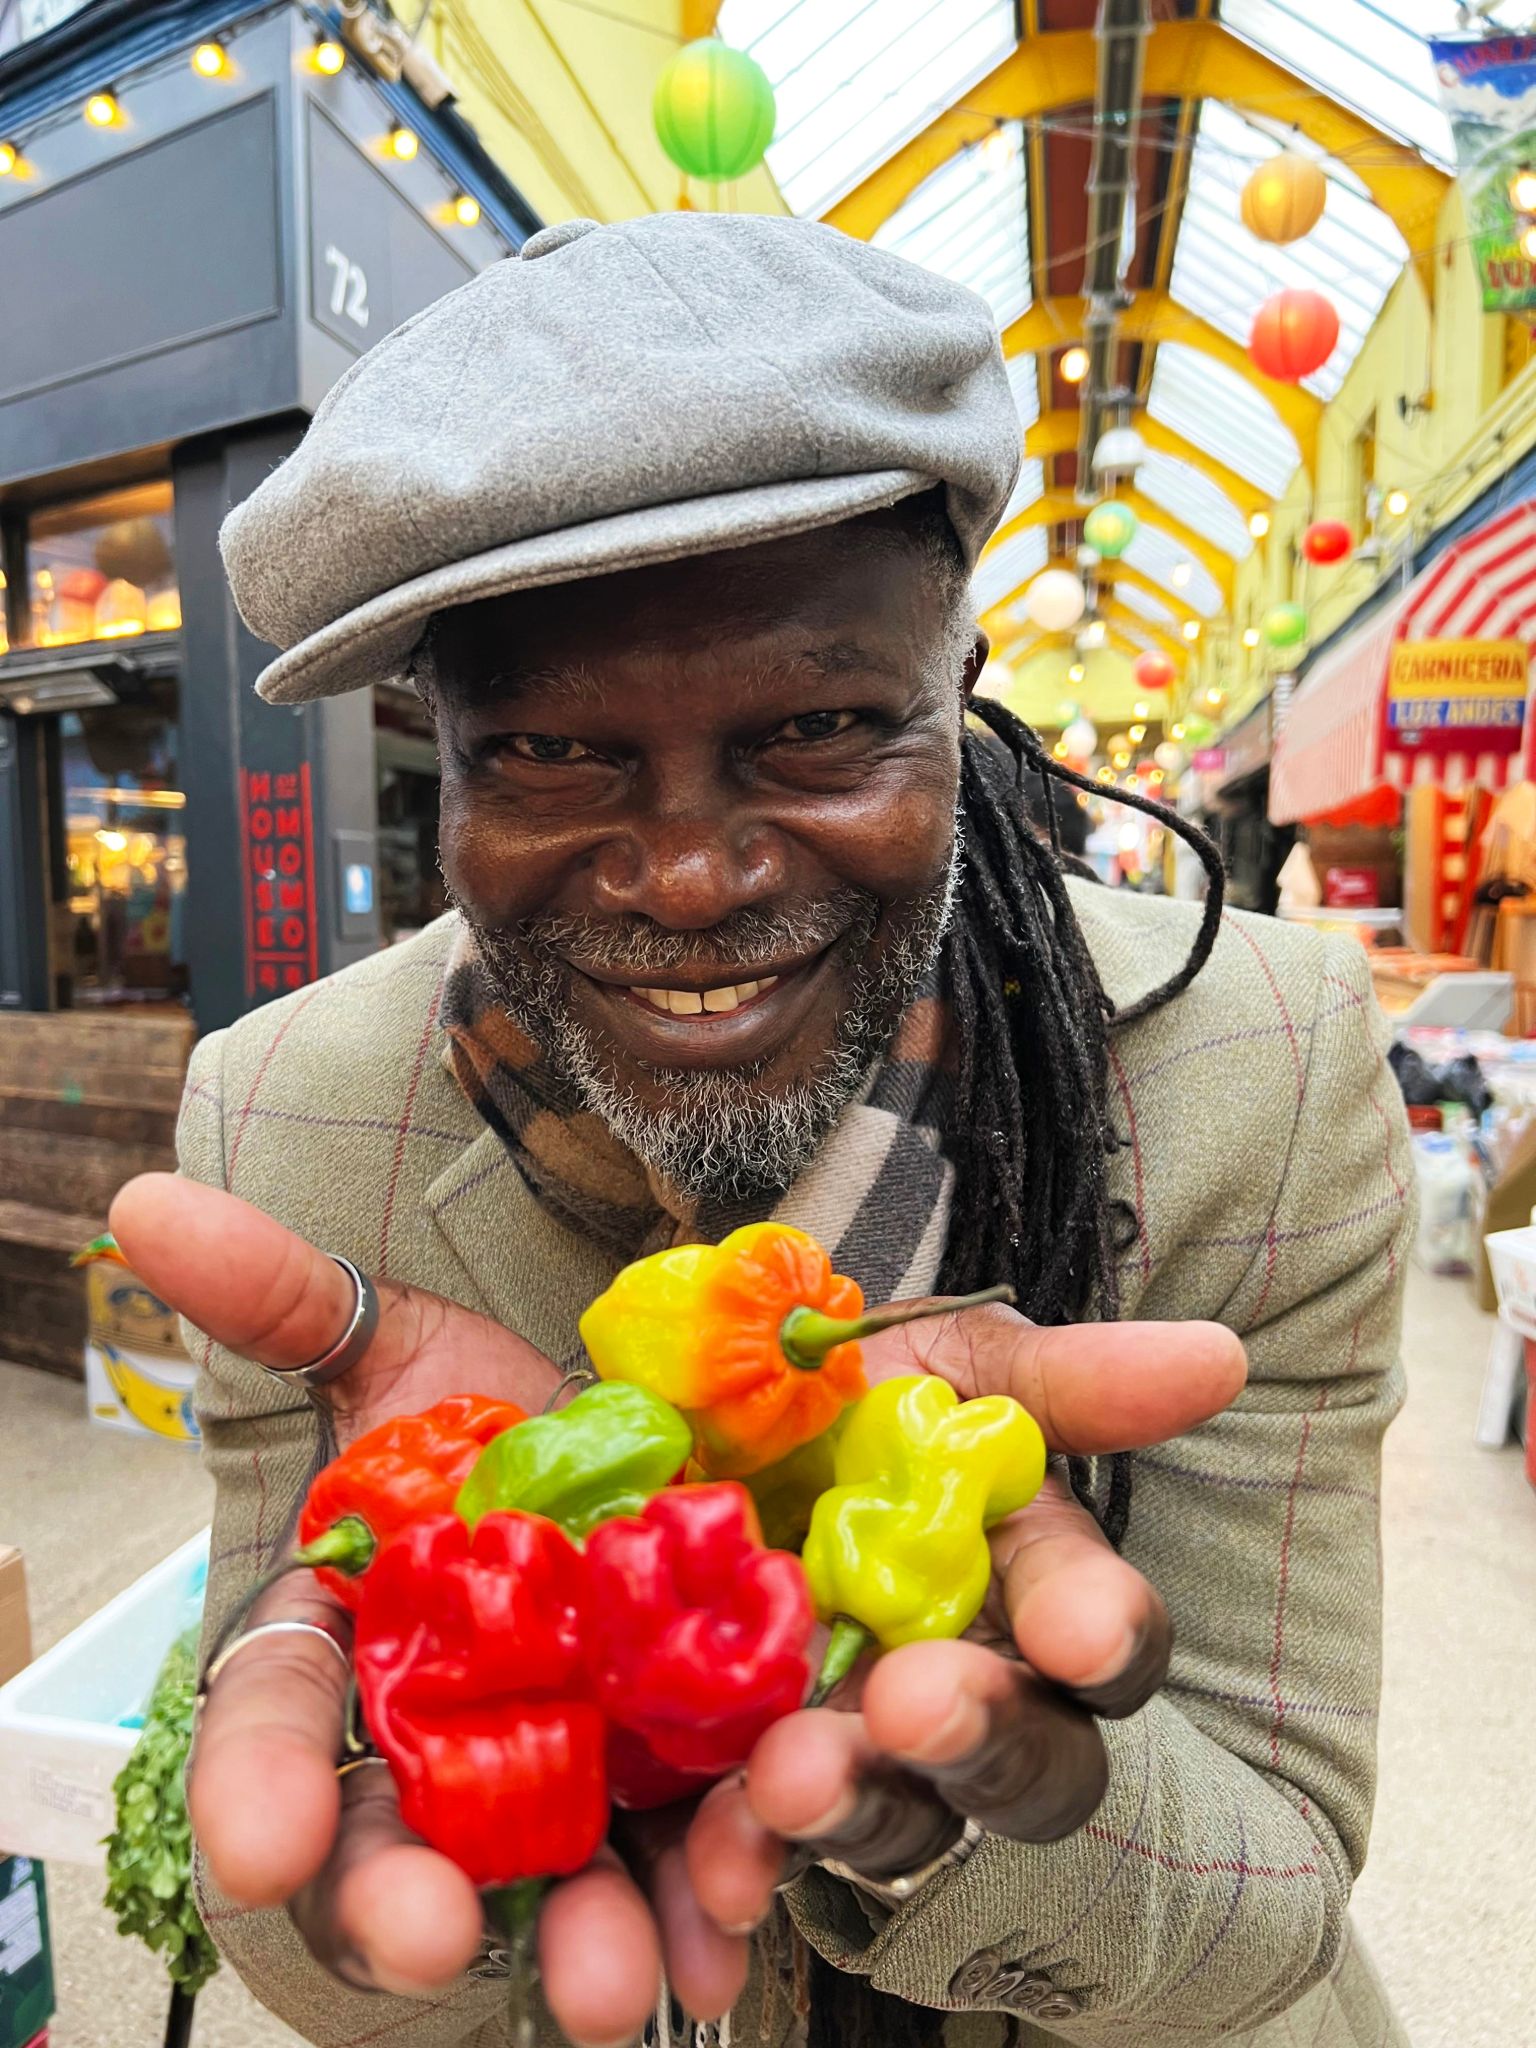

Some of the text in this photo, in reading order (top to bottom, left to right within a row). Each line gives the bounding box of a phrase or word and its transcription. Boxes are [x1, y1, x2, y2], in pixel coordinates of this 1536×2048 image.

[325, 244, 369, 328] 72
[1394, 655, 1523, 683] CARNICERIA
[249, 772, 275, 948] HOUSE
[276, 807, 305, 948] MOMO
